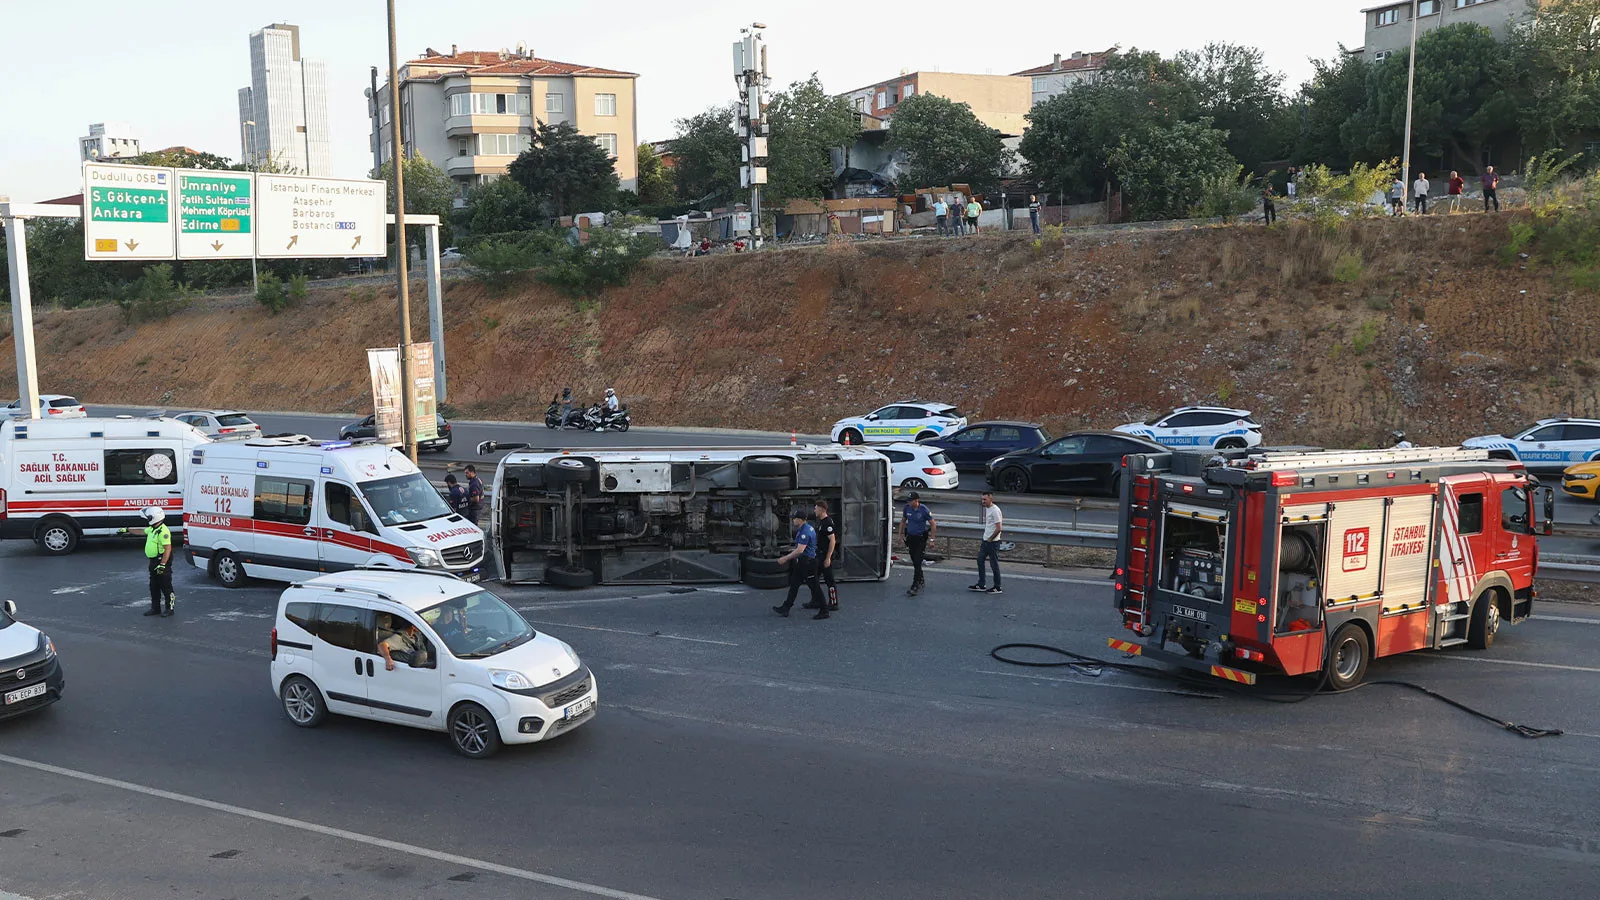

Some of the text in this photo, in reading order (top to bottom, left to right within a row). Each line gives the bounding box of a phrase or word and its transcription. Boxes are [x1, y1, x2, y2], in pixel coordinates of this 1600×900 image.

[92, 170, 157, 183] Dudullu OSB
[180, 176, 237, 194] Ümraniye
[270, 180, 375, 196] İstanbul Finans Merkezi
[92, 190, 156, 205] S.Gökçen
[180, 194, 234, 205] Fatih Sultan
[93, 206, 143, 219] Ankara
[181, 205, 251, 218] Mehmet Köprüsü
[292, 208, 335, 218] Barbaros
[181, 219, 219, 230] Edirne
[52, 453, 67, 462] T.C.
[20, 461, 99, 473] SAĞLIK BAKANLIĞI
[34, 472, 86, 483] ACİL SAĞLIK
[220, 475, 230, 485] T.C.
[123, 499, 169, 507] AMBULANS
[214, 497, 232, 513] 112
[188, 514, 231, 527] AMBULANS
[1393, 525, 1427, 542] İSTANBUL
[1346, 532, 1366, 553] 112
[20, 690, 32, 699] ECP
